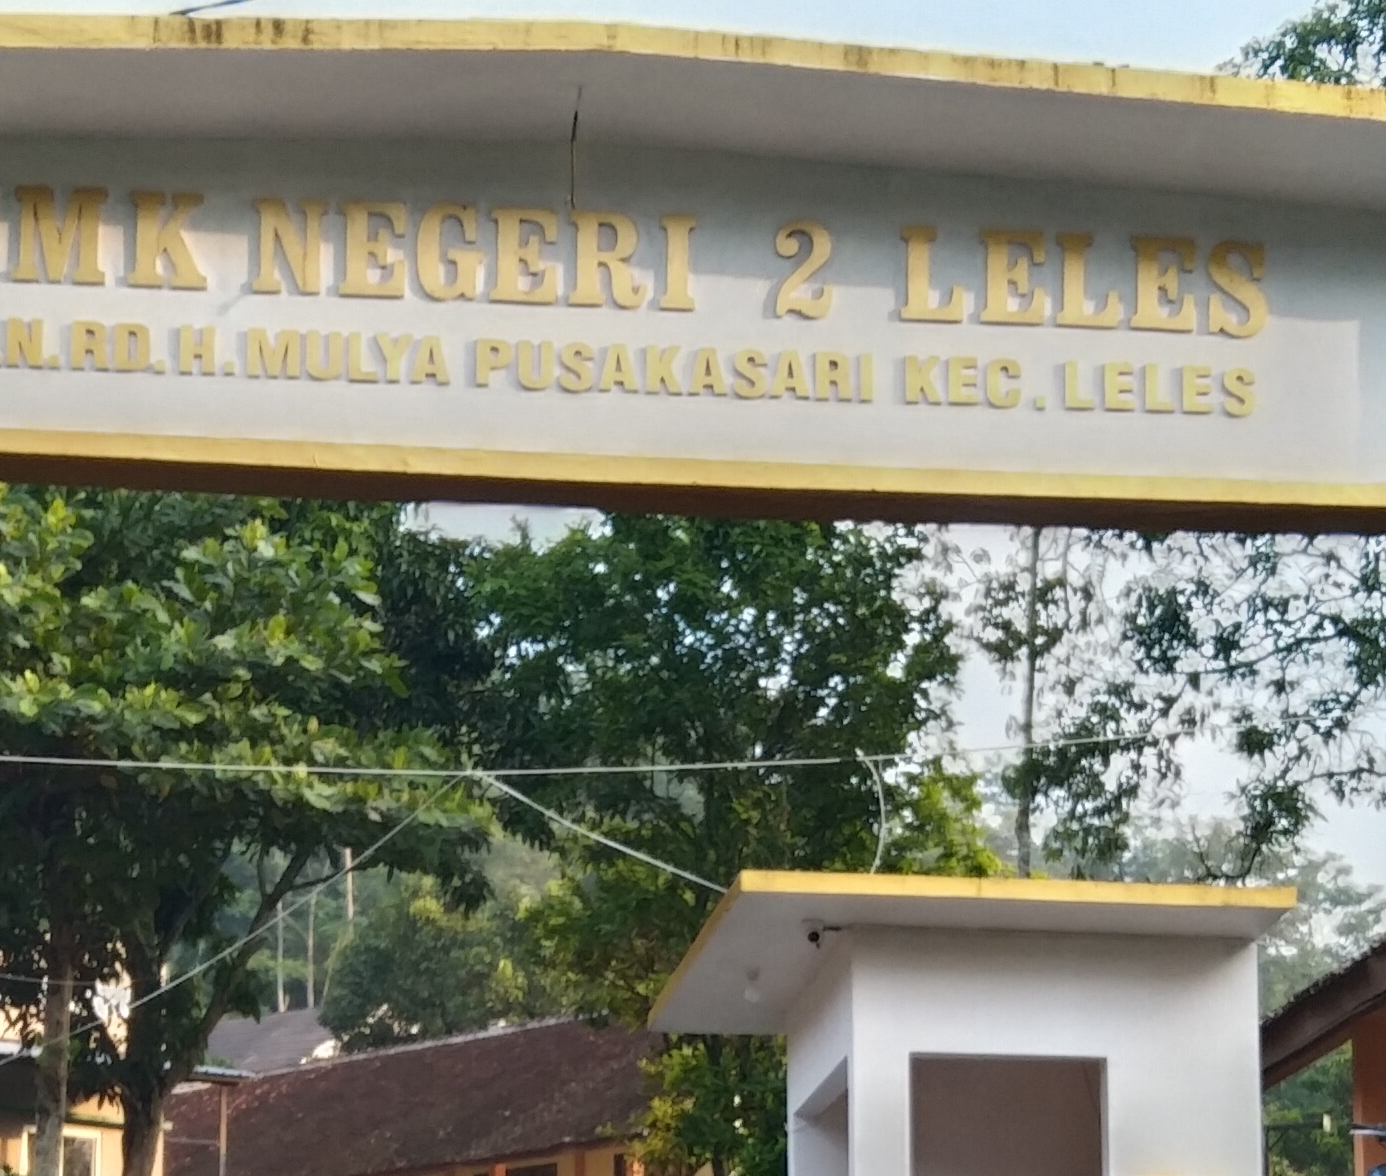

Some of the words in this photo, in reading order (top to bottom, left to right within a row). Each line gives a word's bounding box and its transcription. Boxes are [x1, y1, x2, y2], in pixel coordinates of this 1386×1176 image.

[248, 194, 697, 312] NEGERI
[774, 217, 835, 320] 2
[899, 225, 1270, 339] LELES
[473, 336, 874, 404] PUSAKASARI
